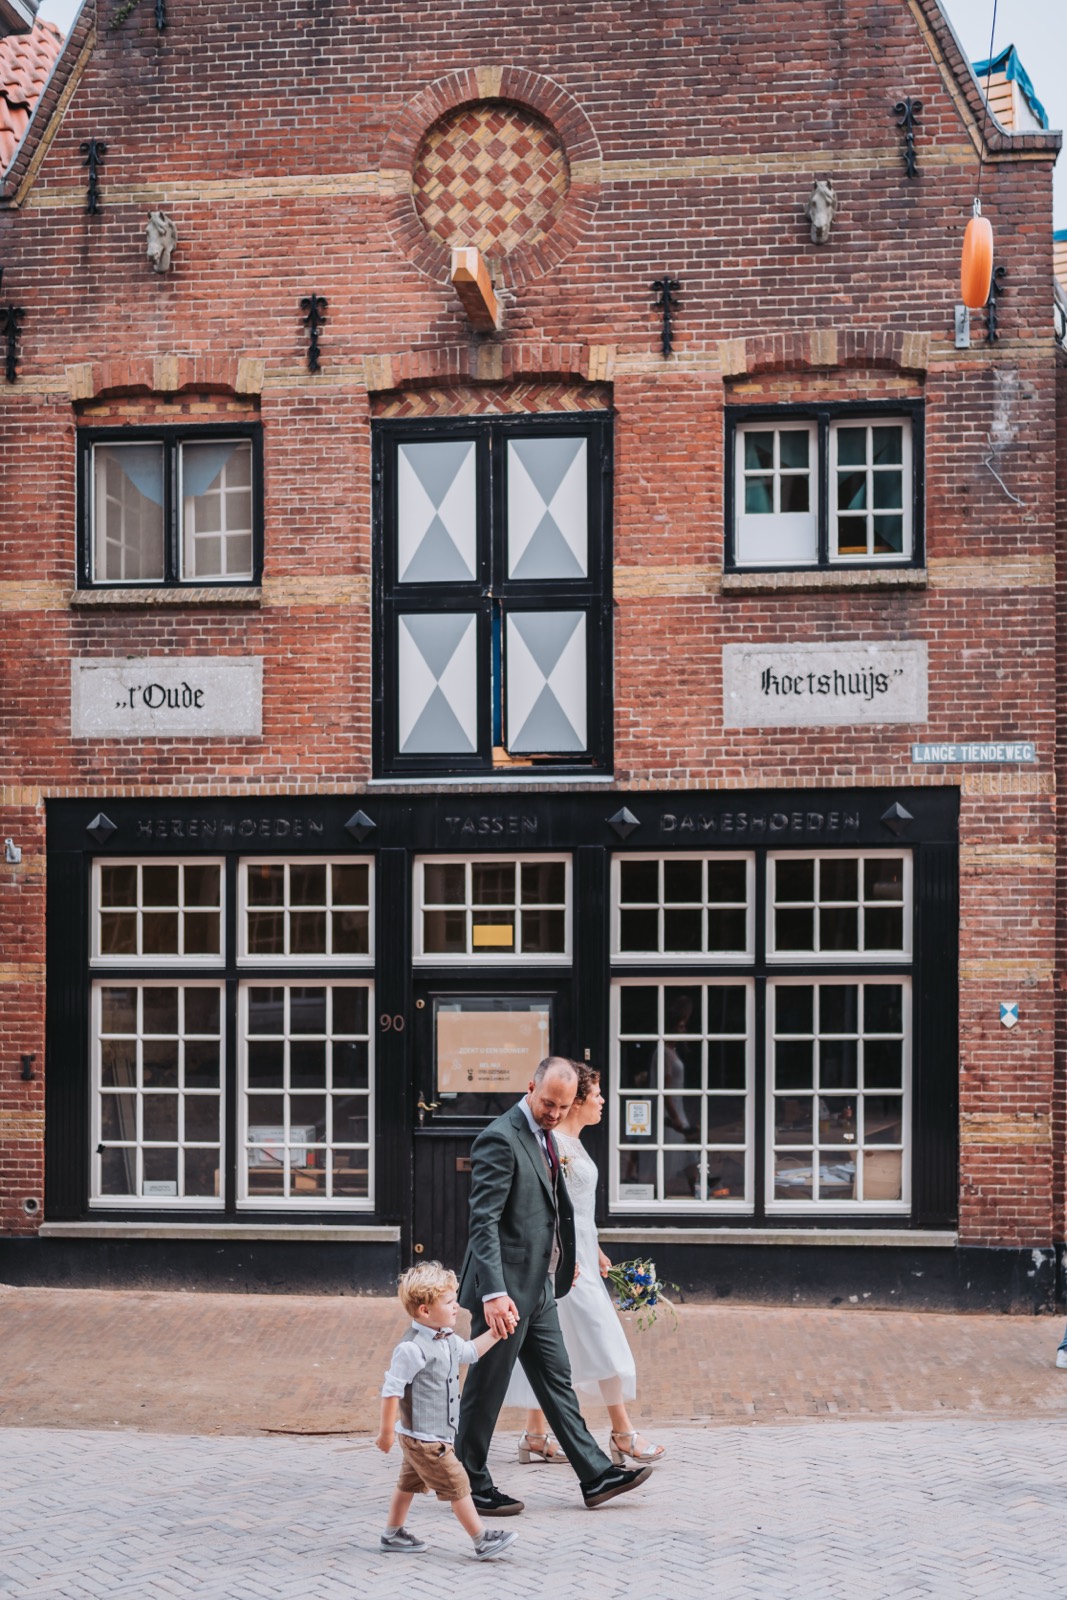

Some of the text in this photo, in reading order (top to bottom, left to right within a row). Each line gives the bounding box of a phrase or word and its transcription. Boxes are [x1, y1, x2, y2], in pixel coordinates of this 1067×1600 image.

[914, 745, 1032, 761] LANGE TIENDEWEG
[136, 817, 323, 837] HERENHOEDEN
[445, 816, 538, 834] TASSEN
[660, 812, 860, 832] DAMESHOEDEN
[380, 1014, 405, 1032] 90
